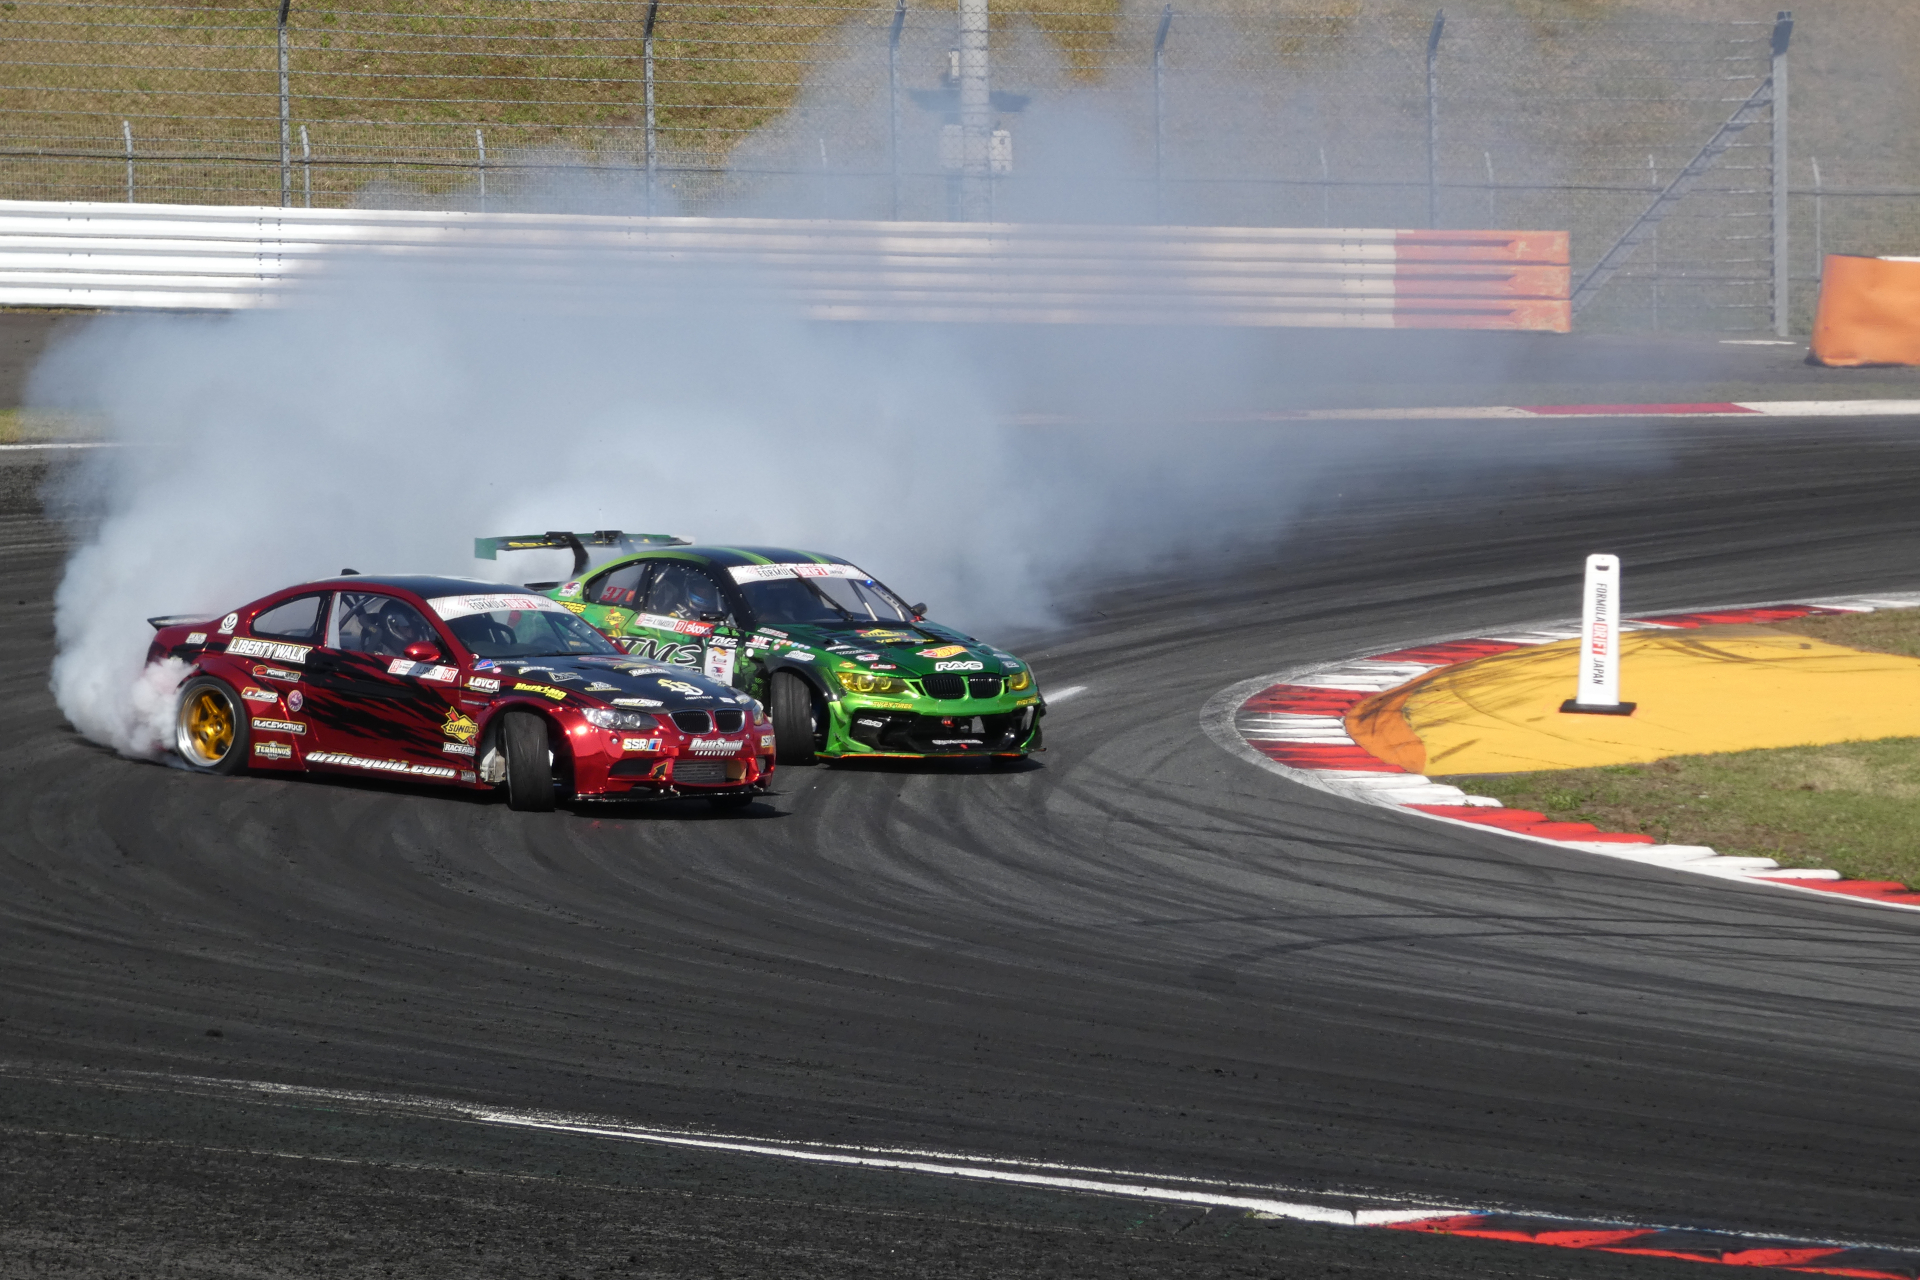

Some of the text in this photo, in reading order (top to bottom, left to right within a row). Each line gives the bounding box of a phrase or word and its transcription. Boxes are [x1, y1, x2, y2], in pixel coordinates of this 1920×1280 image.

[757, 567, 797, 577] FORMUL
[469, 601, 507, 610] FORMULA
[1592, 583, 1608, 685] FORMULA DRIFT JAPAN
[935, 660, 983, 671] RAYS
[468, 676, 499, 690] LOVCA
[254, 719, 304, 732] RACEWORKS
[448, 723, 478, 734] SUNOCO
[622, 738, 648, 751] SSR
